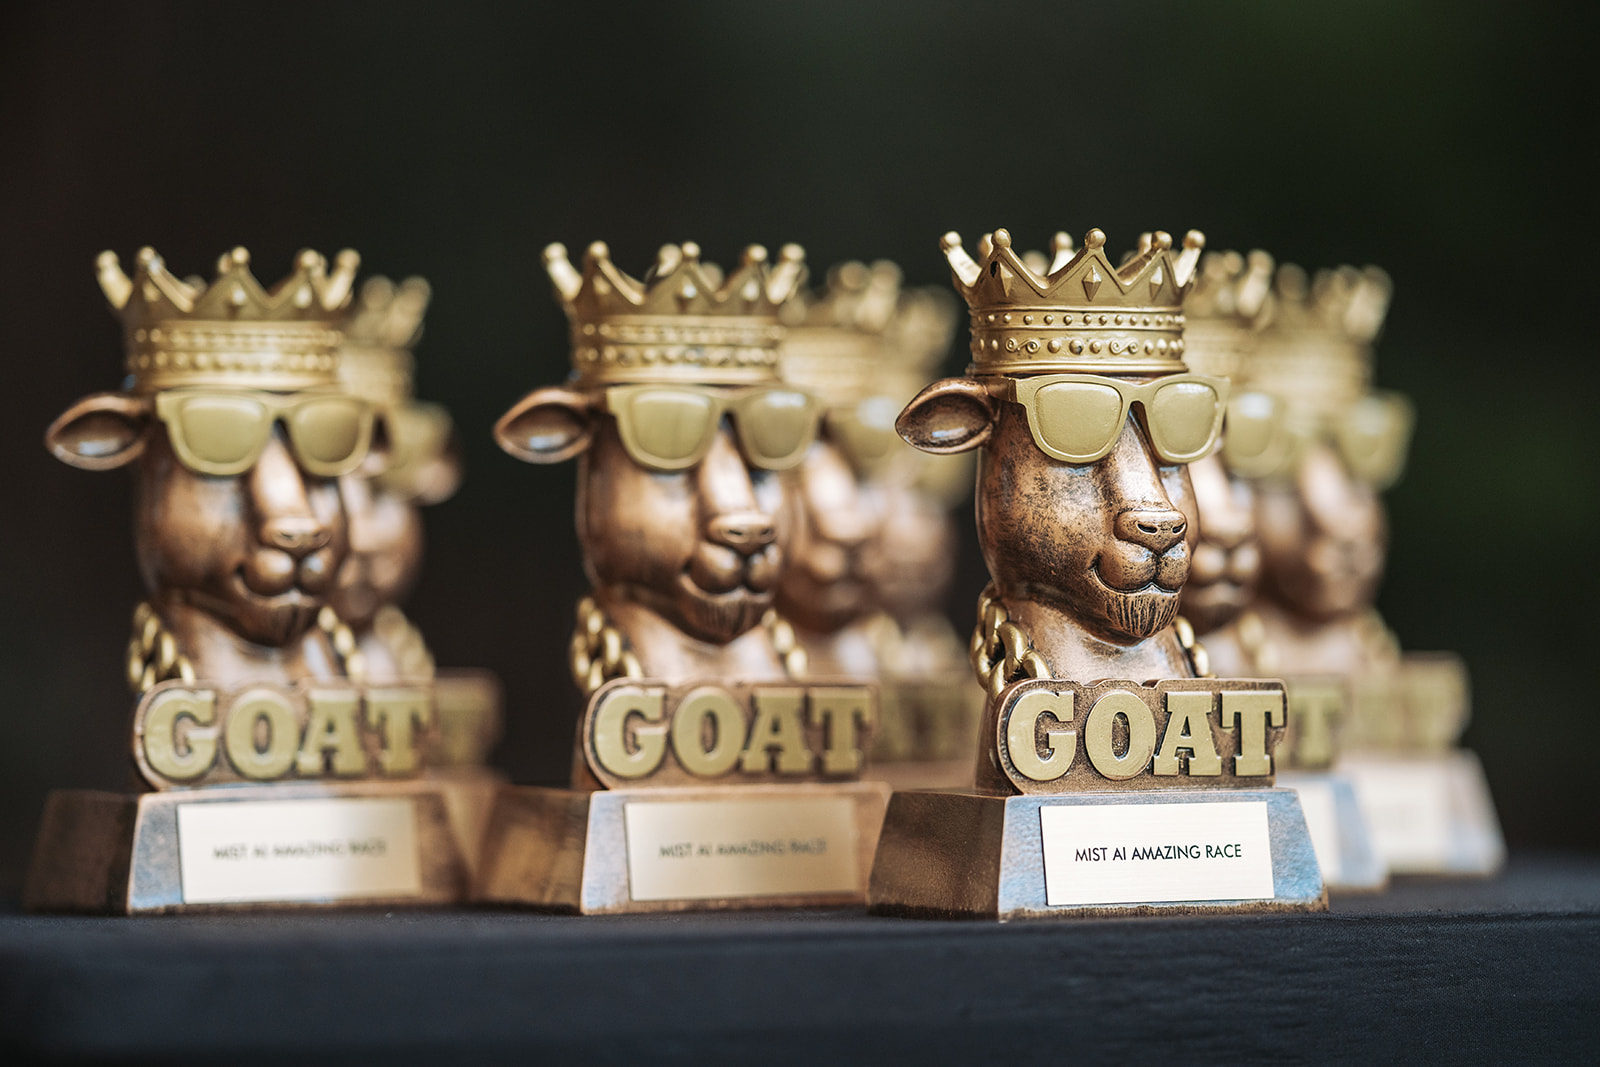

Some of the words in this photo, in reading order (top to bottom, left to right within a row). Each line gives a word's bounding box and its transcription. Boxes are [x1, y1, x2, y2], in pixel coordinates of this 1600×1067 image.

[143, 687, 431, 780] GOAT
[593, 685, 875, 779] GOAT
[1006, 688, 1284, 781] GOAT
[1075, 847, 1108, 862] MIST
[1112, 847, 1127, 861] AI
[1131, 844, 1201, 861] AMAZING
[1205, 843, 1242, 859] RACE
